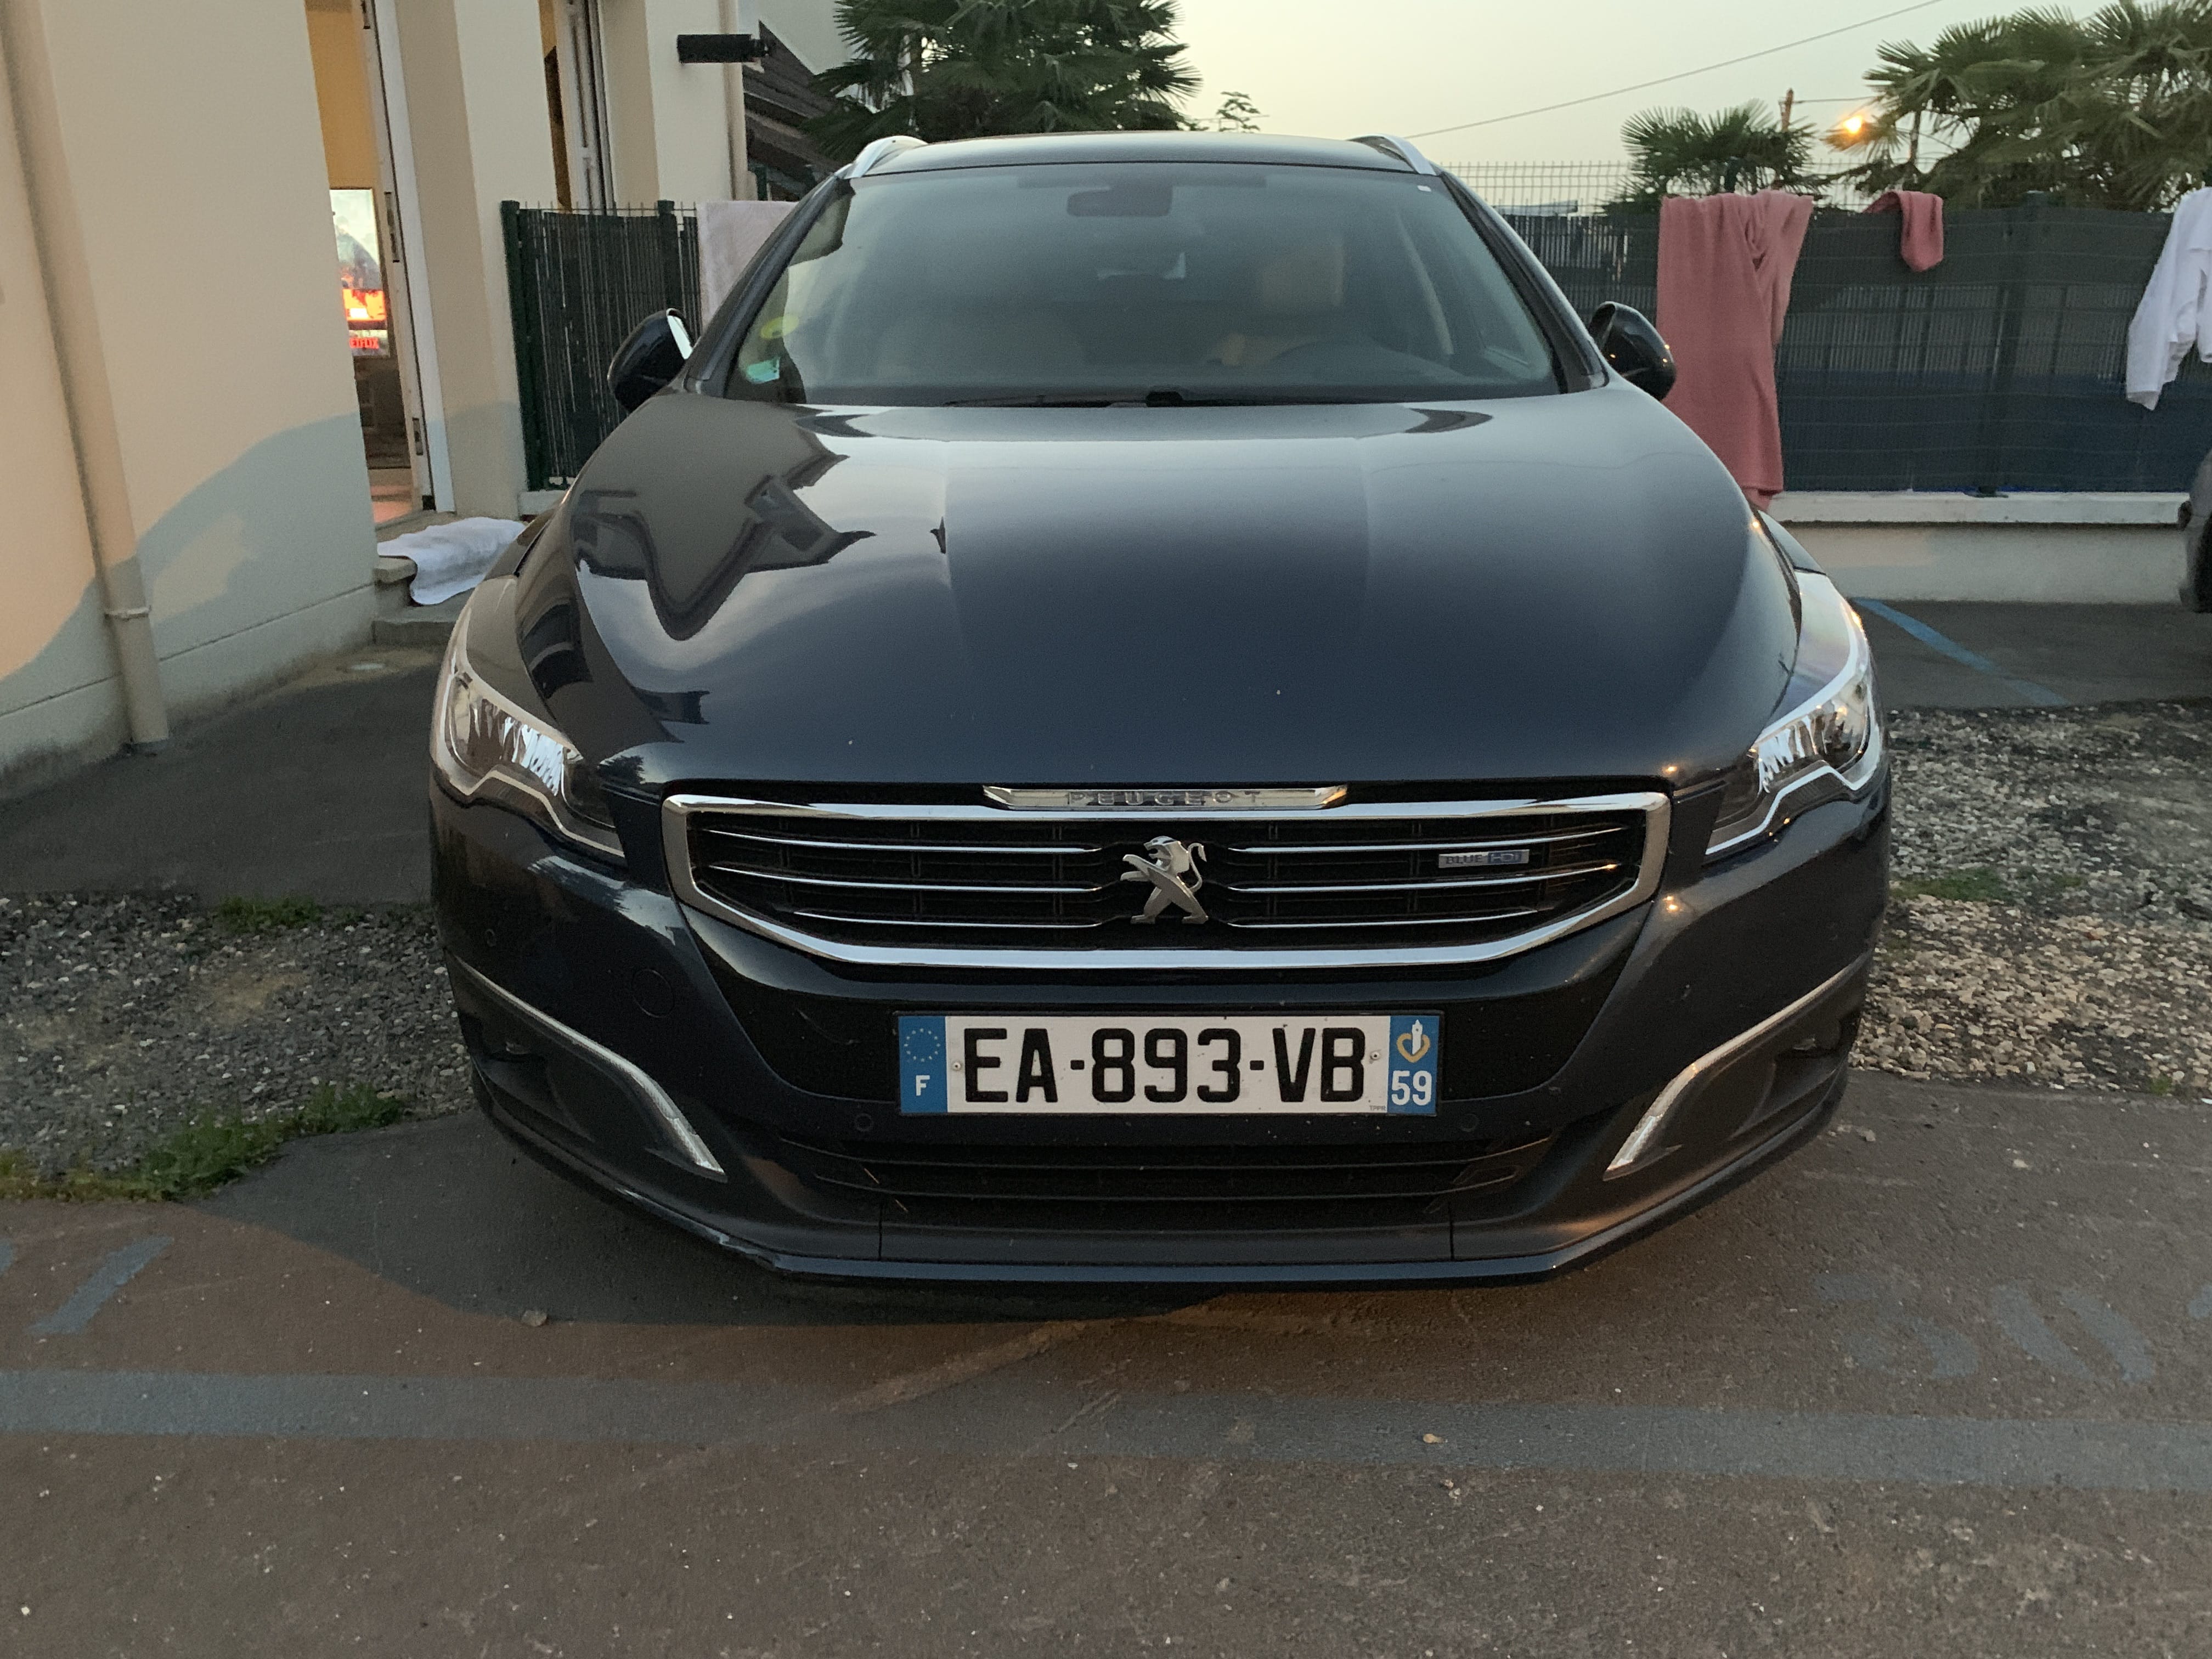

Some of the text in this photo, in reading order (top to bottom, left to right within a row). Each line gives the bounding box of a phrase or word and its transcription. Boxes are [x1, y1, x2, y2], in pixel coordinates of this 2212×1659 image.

[349, 337, 379, 349] ETFLIX
[1068, 790, 1260, 806] PEUGEOT
[1446, 855, 1483, 865] BLUE
[964, 1028, 1365, 1103] EA-893-VB
[916, 1075, 930, 1096] F
[1391, 1070, 1432, 1105] 59
